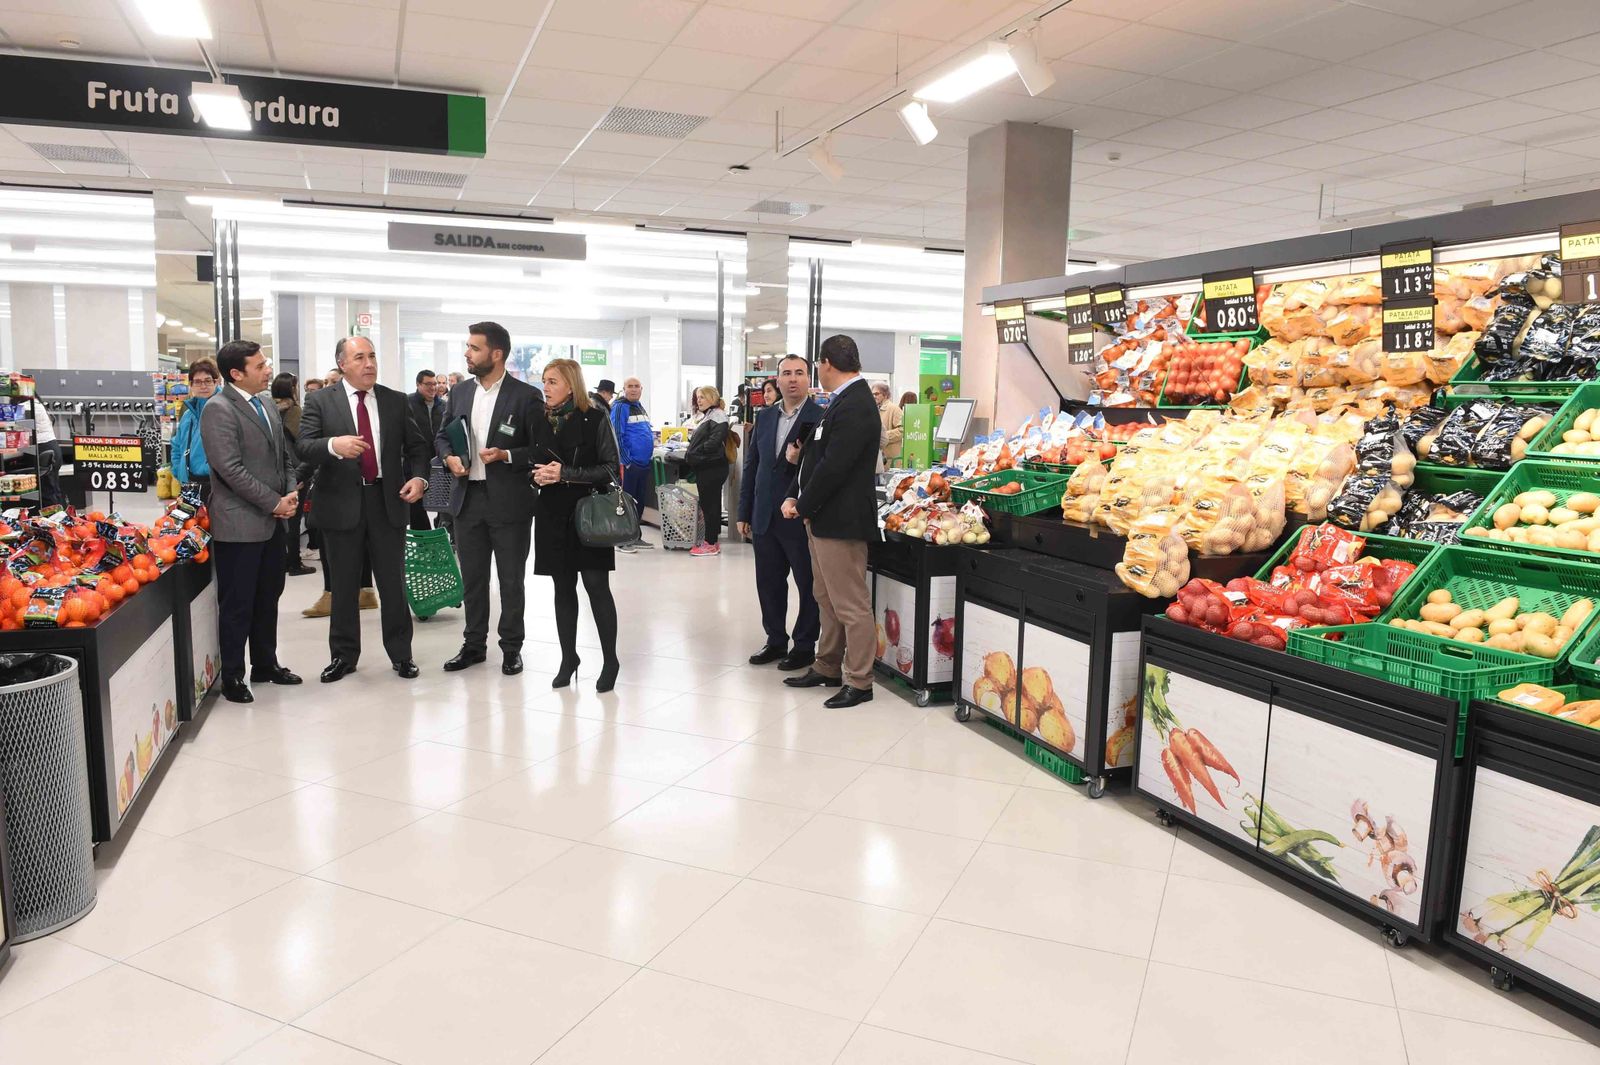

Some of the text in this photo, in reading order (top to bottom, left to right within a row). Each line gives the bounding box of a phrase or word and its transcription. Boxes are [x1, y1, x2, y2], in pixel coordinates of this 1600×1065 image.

[87, 81, 179, 115] Fruta
[434, 233, 496, 249] SALIDA
[511, 244, 545, 252] COMPRA
